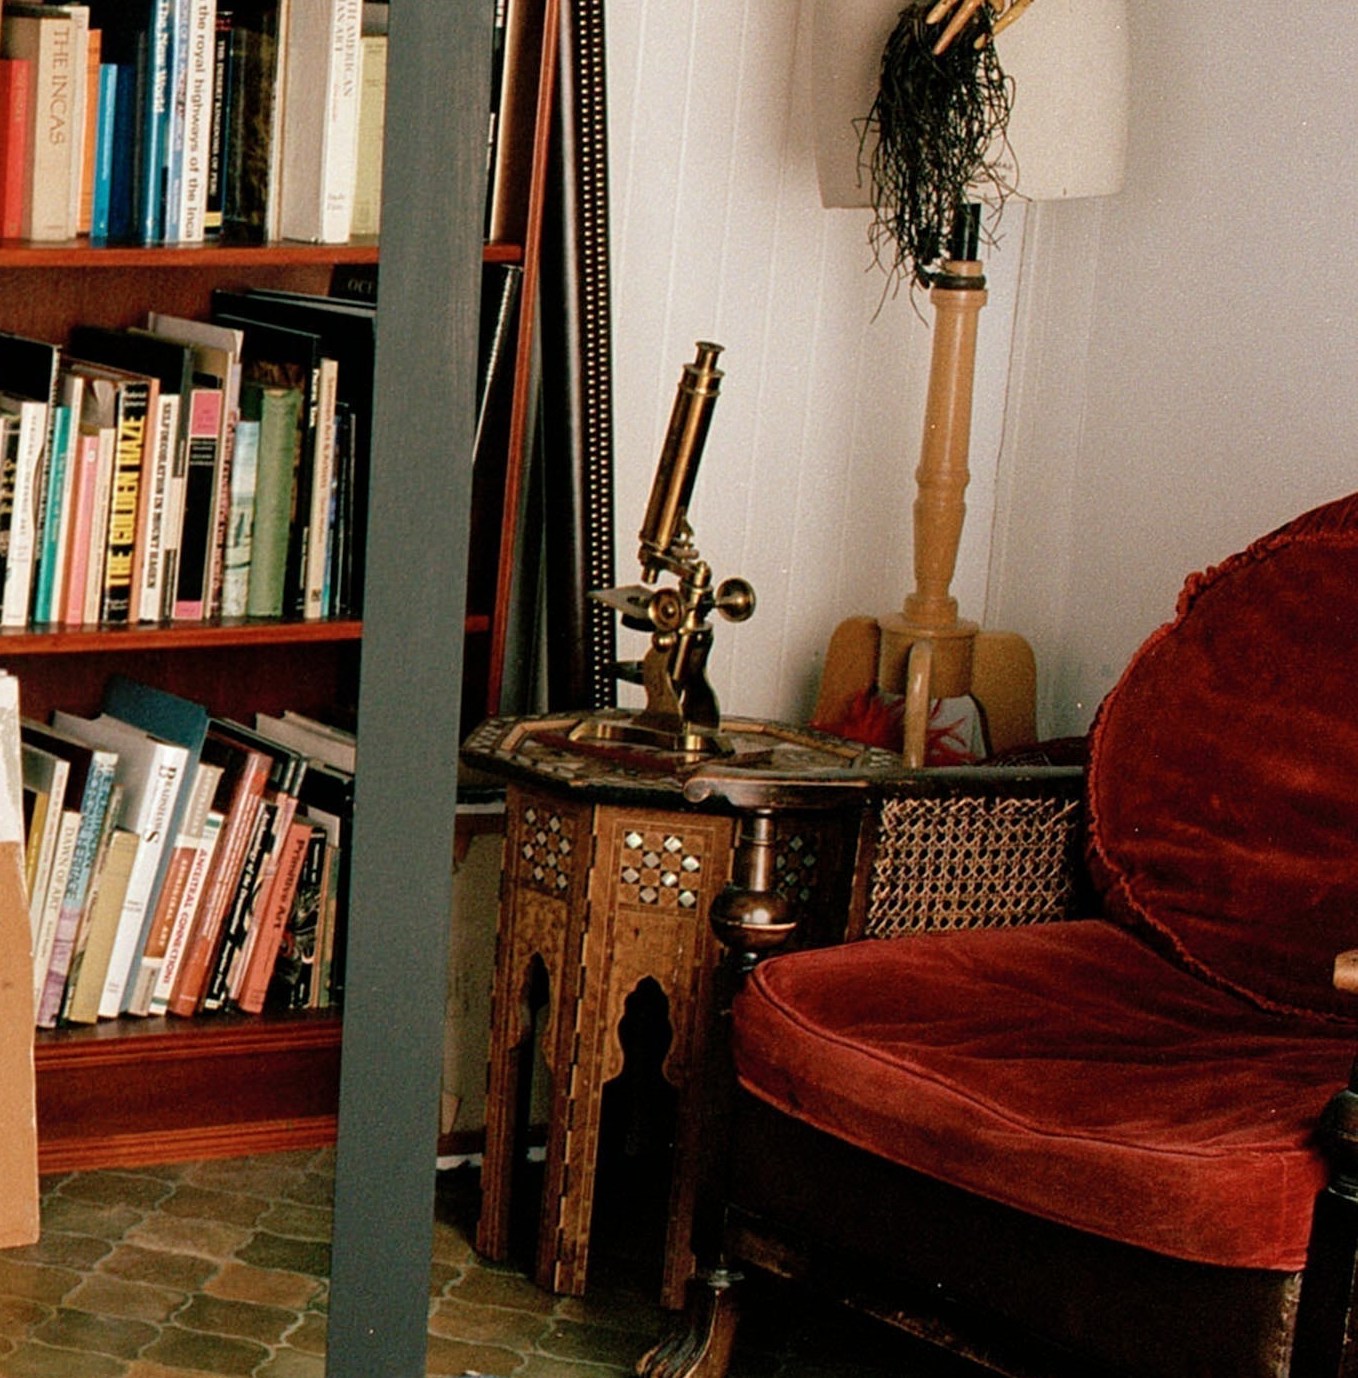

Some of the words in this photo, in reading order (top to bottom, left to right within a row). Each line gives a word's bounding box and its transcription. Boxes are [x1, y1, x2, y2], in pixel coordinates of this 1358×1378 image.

[52, 27, 69, 70] THE
[50, 72, 67, 146] INCAS
[110, 472, 139, 545] GOLDEN
[106, 551, 132, 587] THE
[62, 826, 75, 862] DAWN
[55, 867, 66, 884] OF
[183, 847, 208, 908] ANCESTRAL
[49, 885, 61, 910] ART
[163, 910, 191, 986] CONNECTIONS
